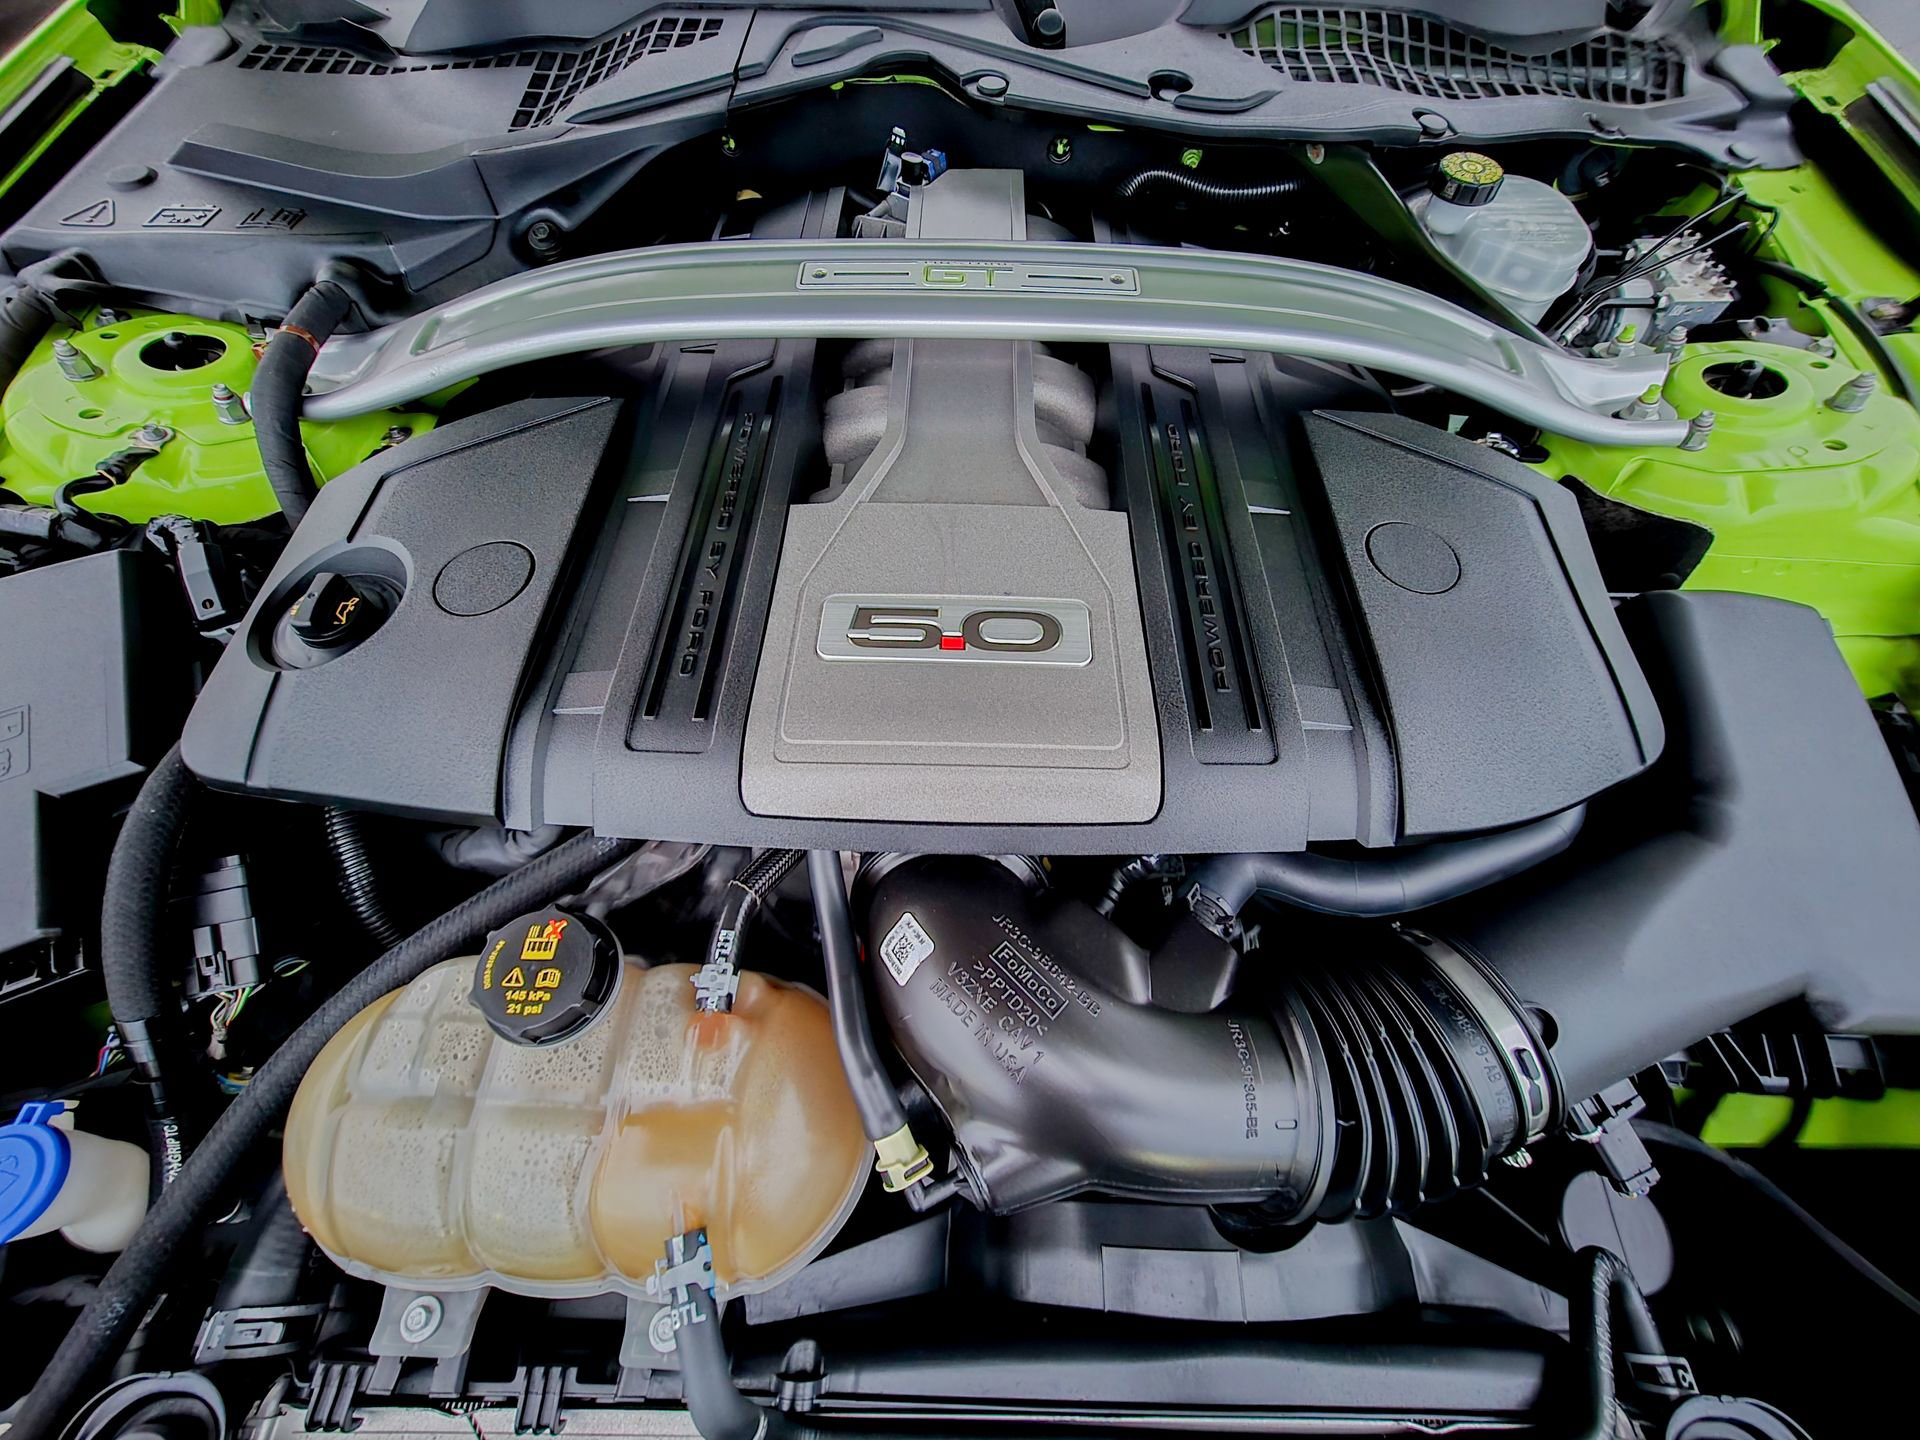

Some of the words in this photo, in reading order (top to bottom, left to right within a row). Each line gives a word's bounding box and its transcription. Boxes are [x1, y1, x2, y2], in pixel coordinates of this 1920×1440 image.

[922, 264, 1014, 287] GT
[715, 411, 756, 531] POWERED
[1167, 423, 1190, 487] FORD
[1179, 496, 1199, 531] BY
[704, 541, 727, 580] BY
[678, 590, 714, 677] FORD
[847, 605, 1064, 652] 5.0
[1188, 542, 1233, 693] POWERED
[505, 989, 527, 1001] 145
[527, 989, 551, 1001] kPa
[997, 947, 1059, 1011] FoMoCo
[506, 1003, 522, 1014] 21
[523, 1003, 543, 1016] psi
[928, 976, 978, 1028] MADE
[973, 1022, 996, 1048] IN
[992, 1042, 1028, 1086] USA
[998, 1014, 1034, 1051] CAV
[671, 1301, 707, 1330] BTL
